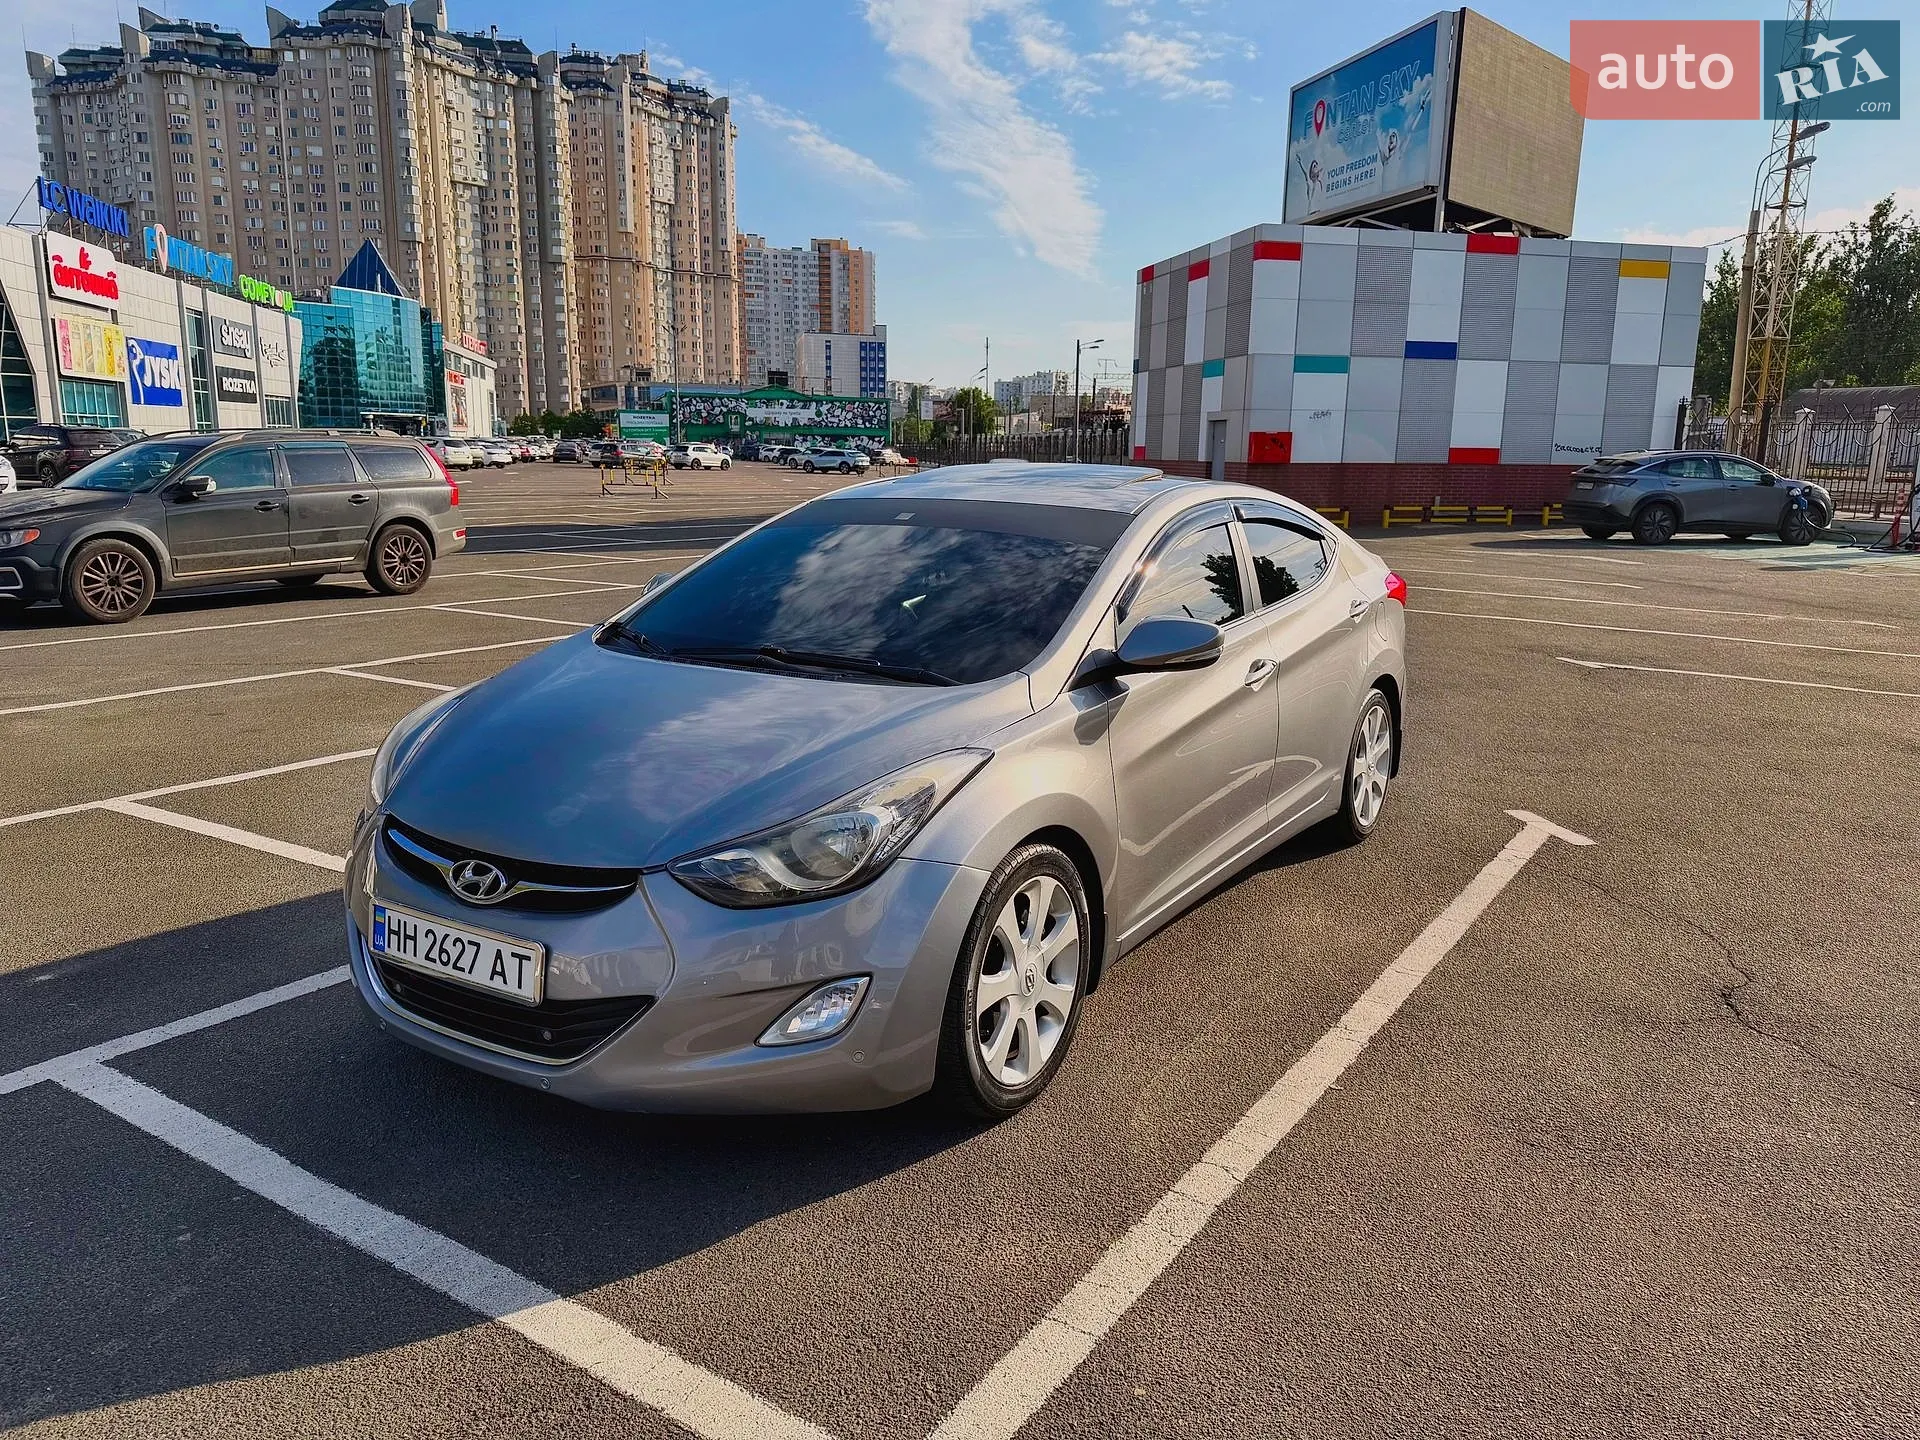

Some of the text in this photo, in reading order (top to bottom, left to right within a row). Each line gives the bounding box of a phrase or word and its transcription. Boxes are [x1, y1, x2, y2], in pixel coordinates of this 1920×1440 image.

[1304, 60, 1420, 137] FONTAN SKY
[1326, 176, 1352, 192] BEGINS
[1354, 167, 1377, 183] HERE!
[1327, 153, 1378, 179] YOUR FREEDOM
[37, 176, 64, 213] LC
[206, 251, 233, 288] SKY
[144, 355, 182, 390] JYSK
[222, 376, 257, 394] ROZETKA
[374, 933, 385, 947] UA
[387, 915, 532, 990] HH 2627 AT
